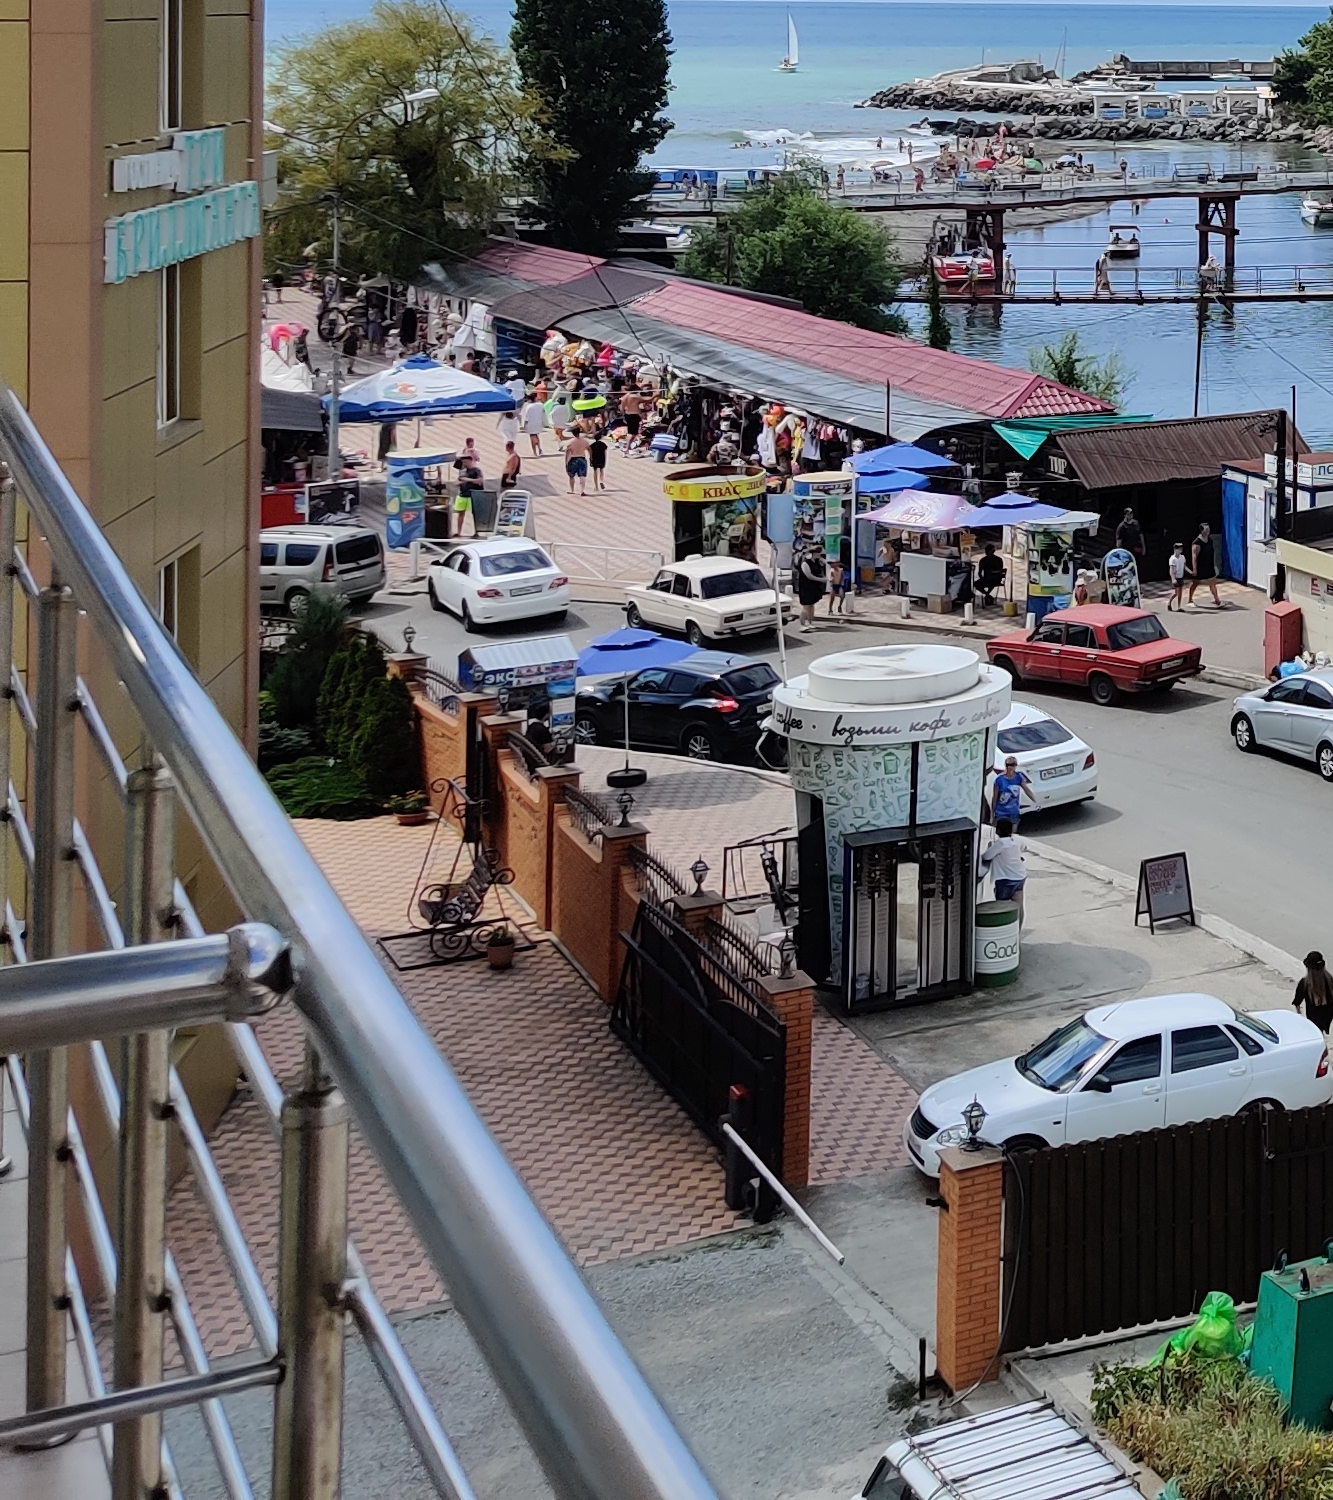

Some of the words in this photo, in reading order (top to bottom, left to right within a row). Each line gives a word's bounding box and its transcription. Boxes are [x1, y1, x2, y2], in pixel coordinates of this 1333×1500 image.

[1048, 455, 1068, 475] ТИР
[702, 484, 742, 499] КВАС
[776, 707, 803, 734] coffee
[831, 714, 903, 745] возьми
[909, 709, 953, 739] кофе
